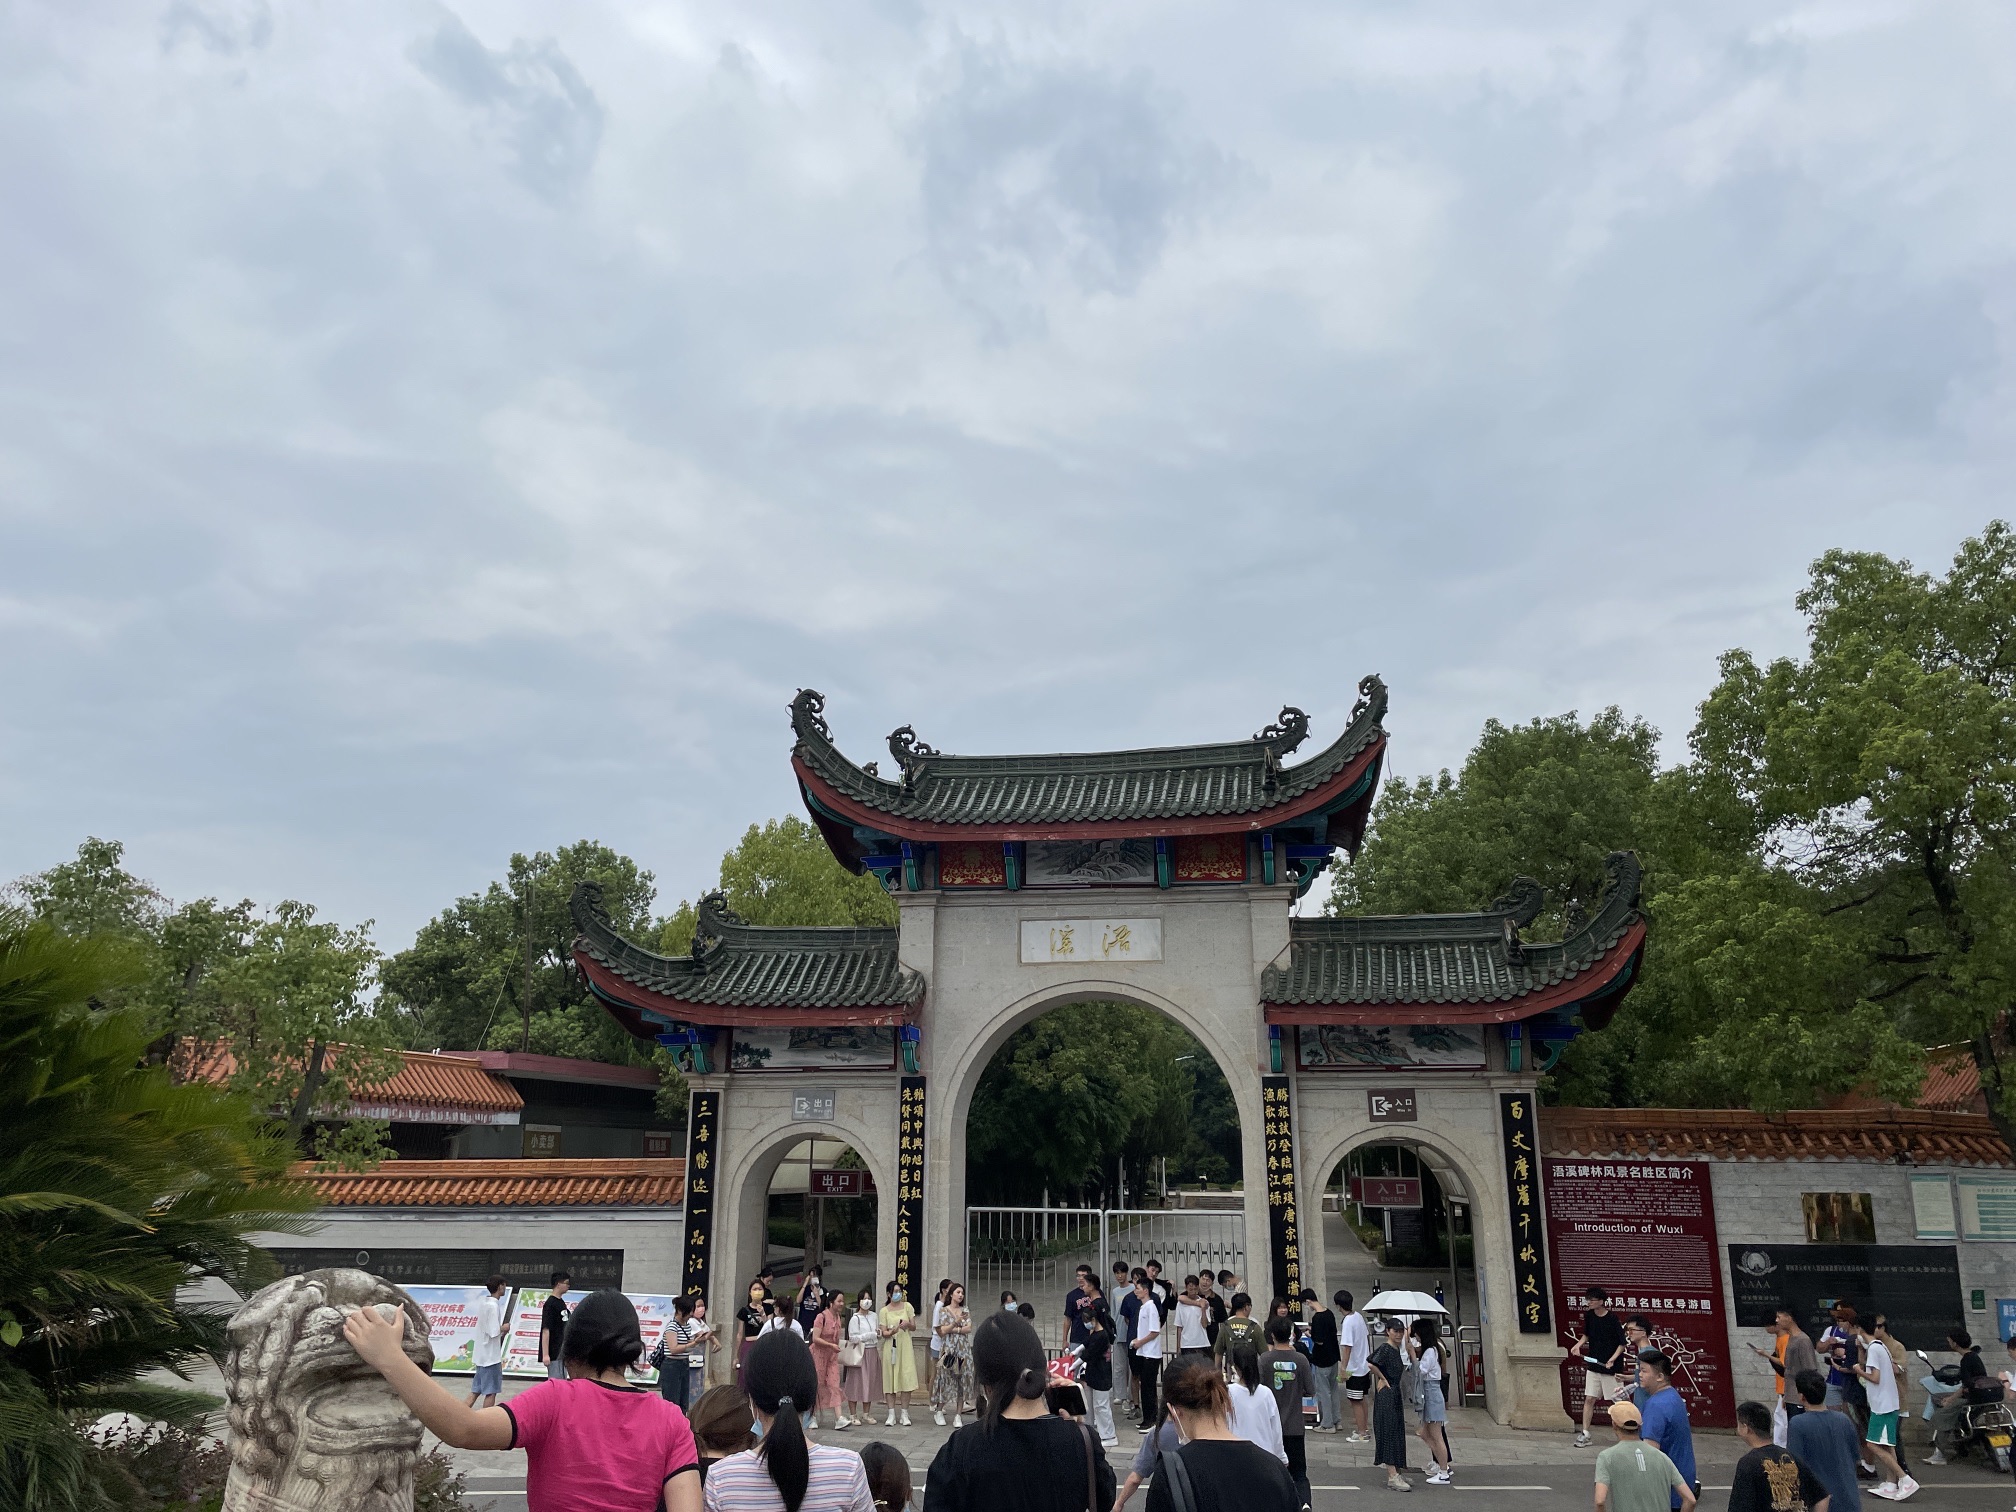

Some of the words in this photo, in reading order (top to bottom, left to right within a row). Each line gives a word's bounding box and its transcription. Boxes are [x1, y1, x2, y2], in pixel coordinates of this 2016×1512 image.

[813, 1098, 833, 1108] 出口
[1395, 1098, 1413, 1106] 入口
[531, 1133, 555, 1149] 小卖部
[1552, 1165, 1694, 1180] 浯溪碑林风景名胜区简介
[822, 1174, 850, 1186] 出口
[1378, 1183, 1407, 1195] 入口
[1574, 1222, 1637, 1233] Introduction
[1641, 1223, 1651, 1233] of
[1655, 1224, 1684, 1234] Wuxi
[420, 1303, 465, 1314] 型冠状病毒
[1567, 1295, 1711, 1310] 浯溪林风景名胜区导游图
